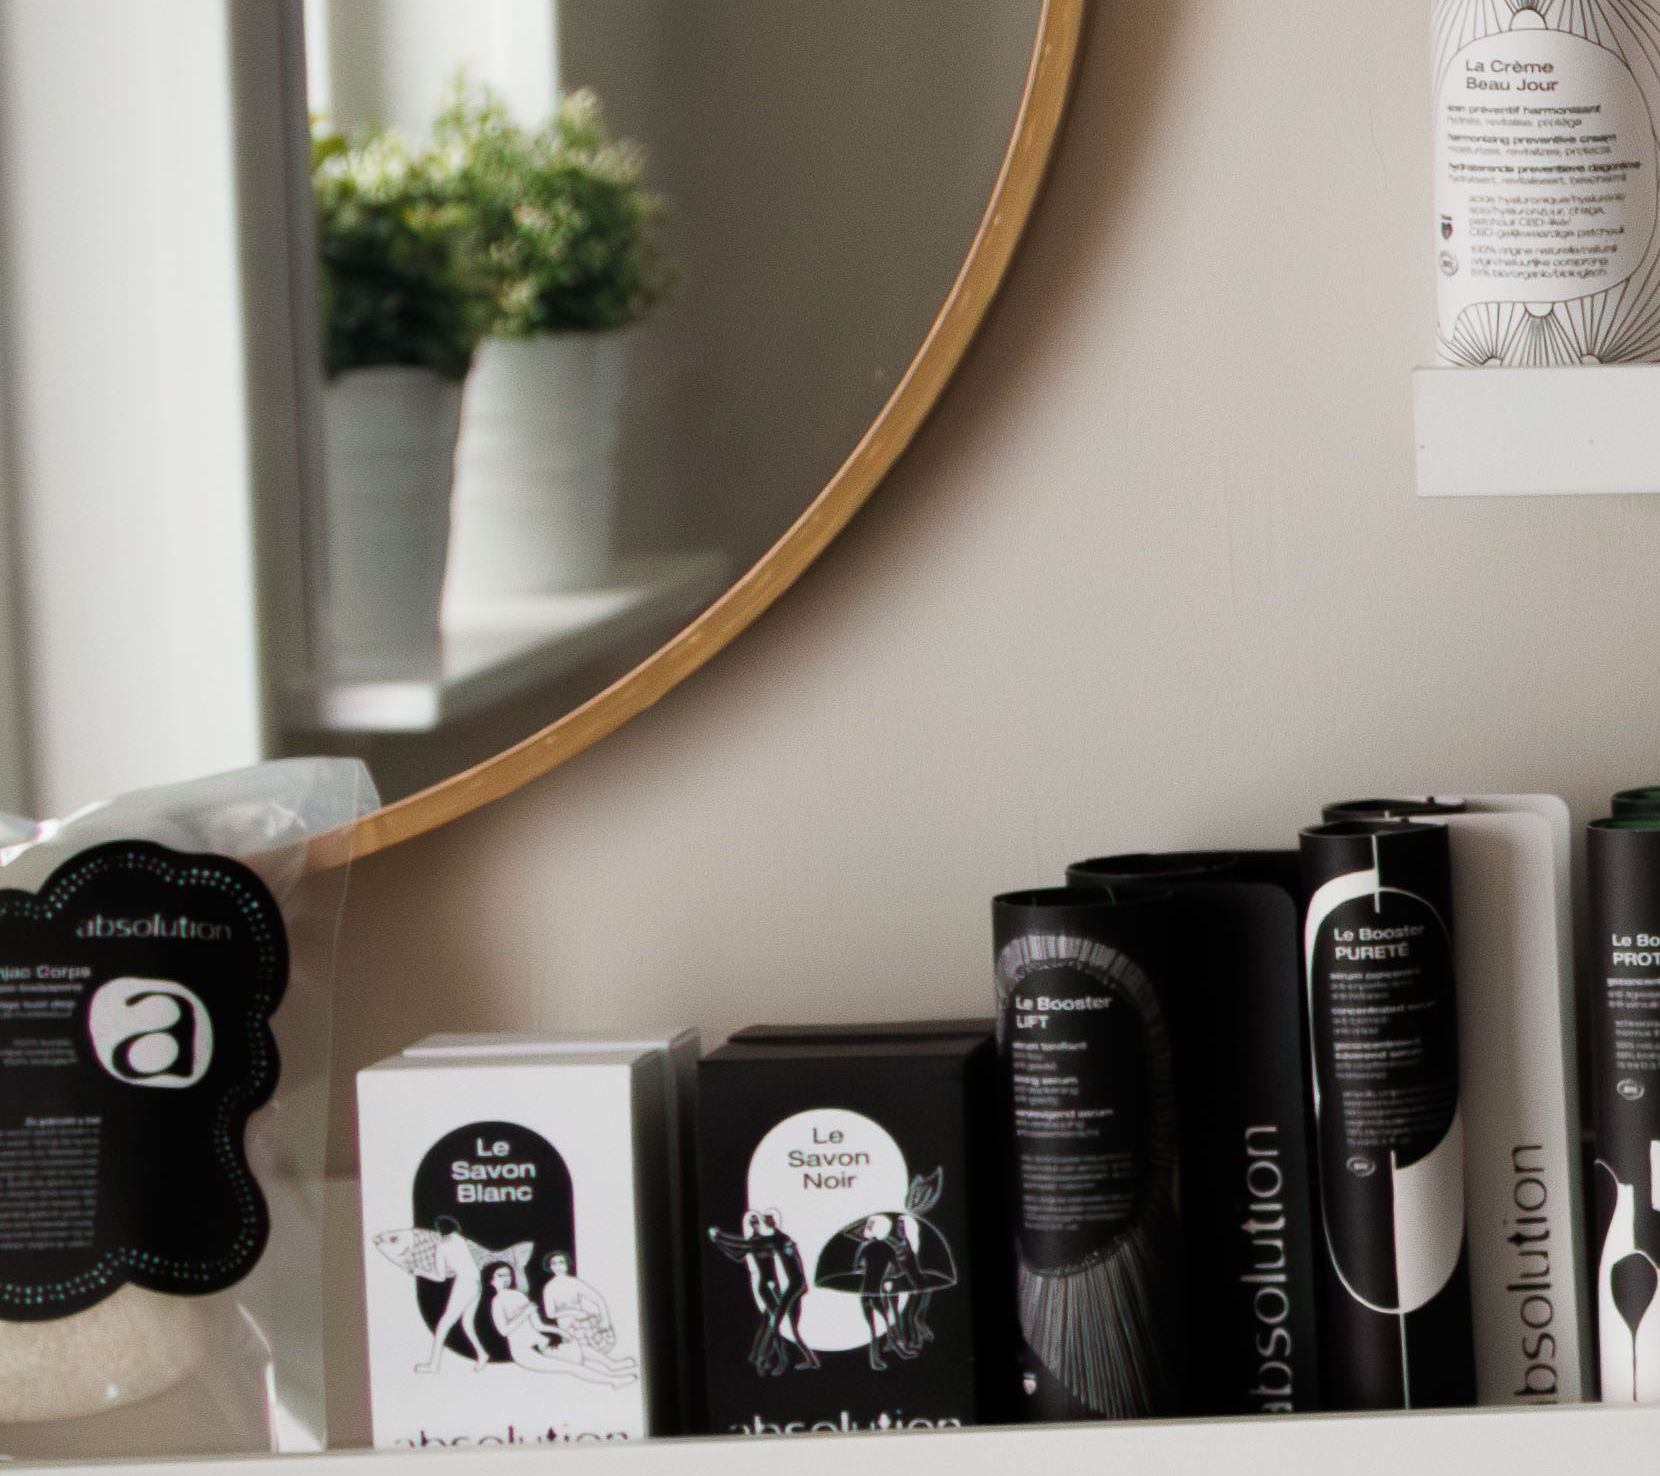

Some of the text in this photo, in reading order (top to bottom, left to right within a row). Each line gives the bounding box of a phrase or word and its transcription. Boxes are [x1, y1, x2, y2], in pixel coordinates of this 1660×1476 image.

[1466, 59, 1554, 73] La Crème
[1466, 77, 1559, 91] Beau Jour
[76, 913, 232, 941] absolution
[1333, 925, 1425, 942] Le Booster
[1612, 933, 1632, 947] Le
[36, 965, 91, 979] Corps
[1015, 995, 1112, 1011] Le Booster
[112, 991, 197, 1080] a
[812, 1127, 844, 1145] Le
[475, 1137, 510, 1158] Le
[787, 1150, 870, 1169] Savon
[450, 1162, 538, 1181] Savon
[802, 1173, 856, 1191] Noir
[456, 1183, 533, 1204] Blanc
[1506, 1143, 1557, 1404] bsolution
